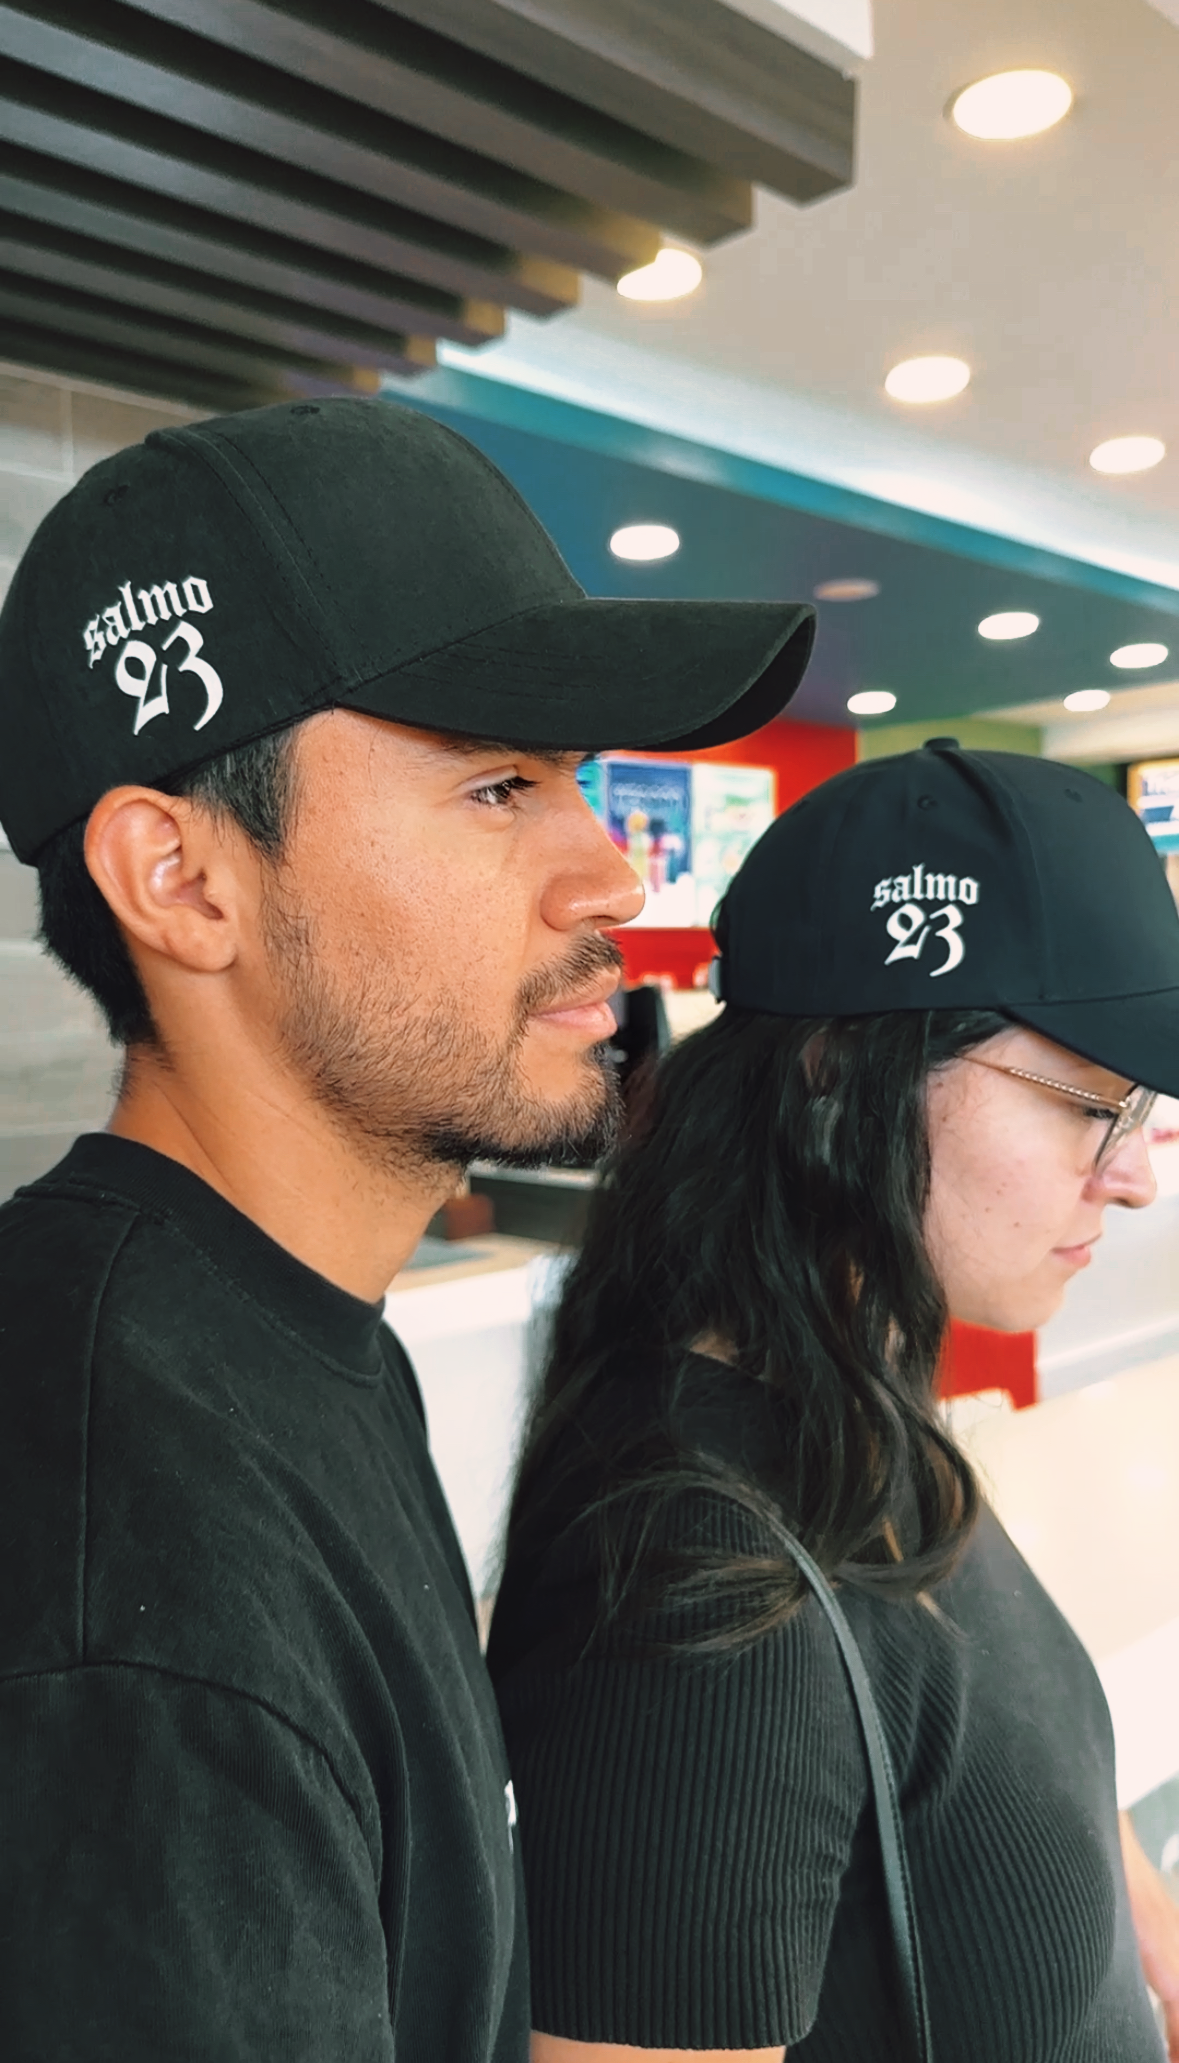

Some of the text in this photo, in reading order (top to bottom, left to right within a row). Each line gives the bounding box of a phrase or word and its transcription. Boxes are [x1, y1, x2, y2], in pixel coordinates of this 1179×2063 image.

[82, 575, 214, 670] salmo
[114, 619, 224, 736] 23
[869, 862, 980, 912] salmo
[884, 902, 965, 978] 23
